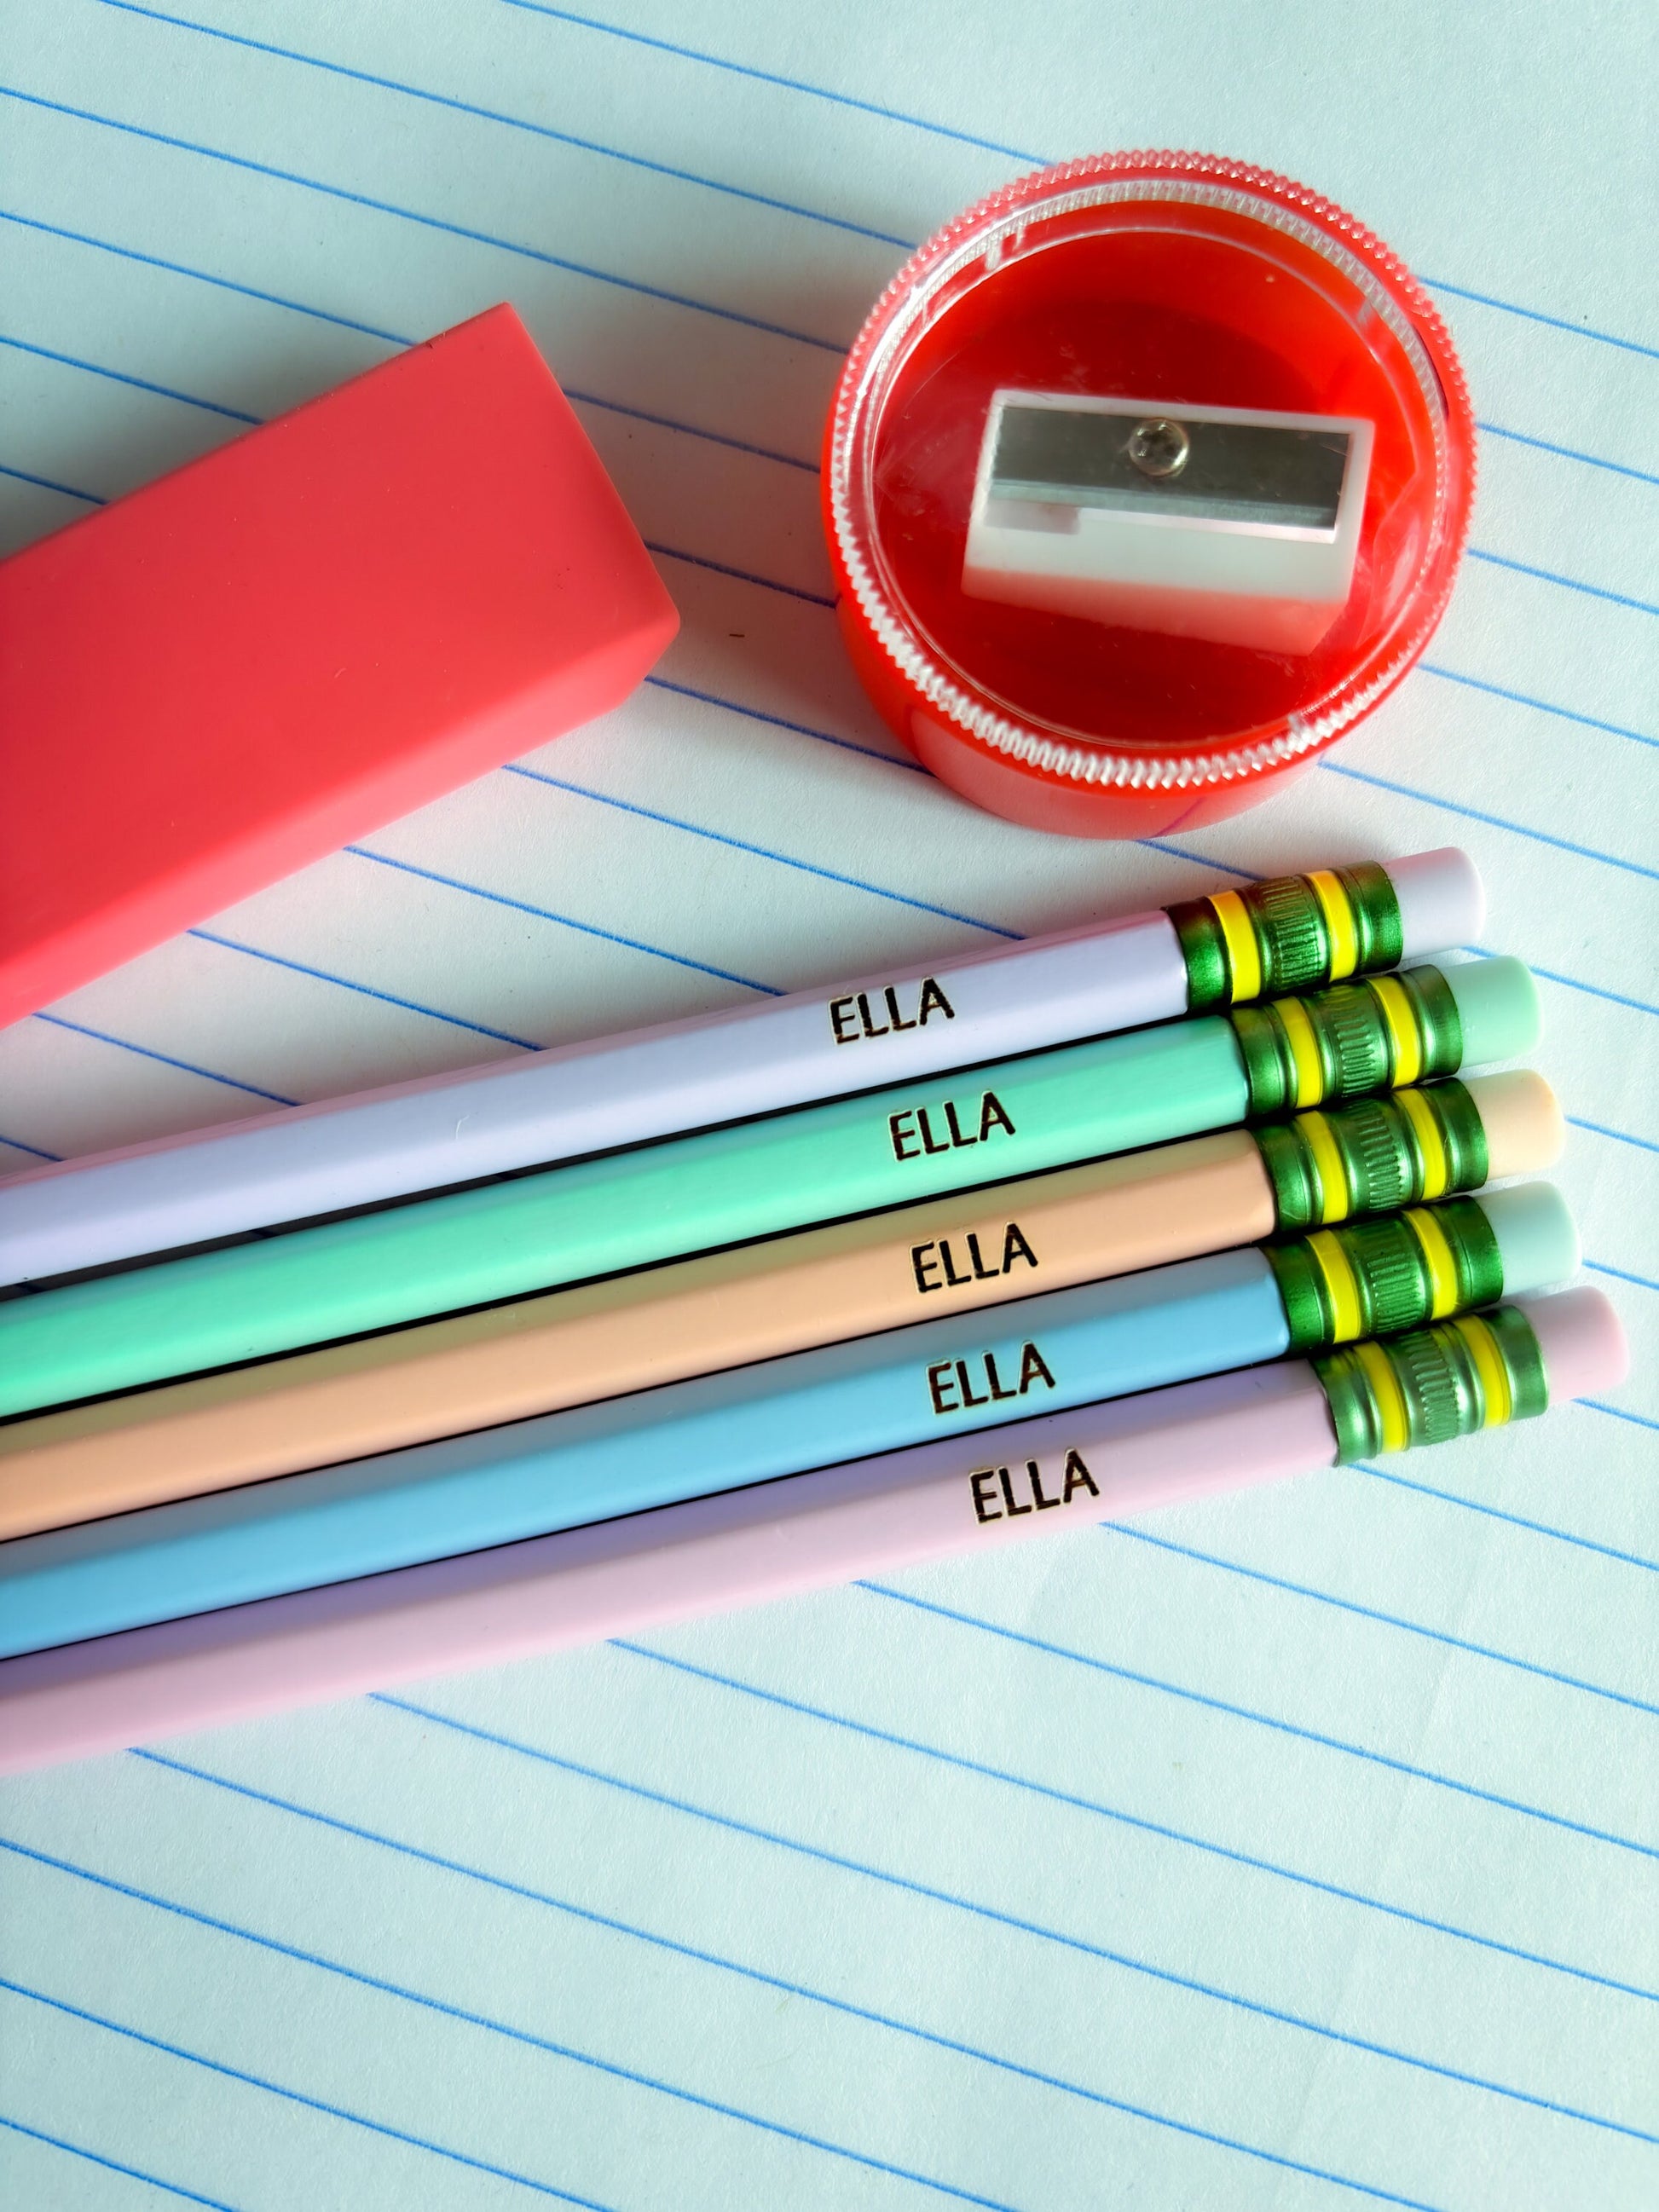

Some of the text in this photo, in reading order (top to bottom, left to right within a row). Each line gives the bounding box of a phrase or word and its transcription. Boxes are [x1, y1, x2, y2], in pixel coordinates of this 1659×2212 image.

[830, 978, 956, 1044] ELLA
[888, 1091, 1016, 1162] ELLA
[910, 1222, 1038, 1294] ELLA
[927, 1343, 1056, 1414] ELLA
[970, 1449, 1100, 1523] ELLA
